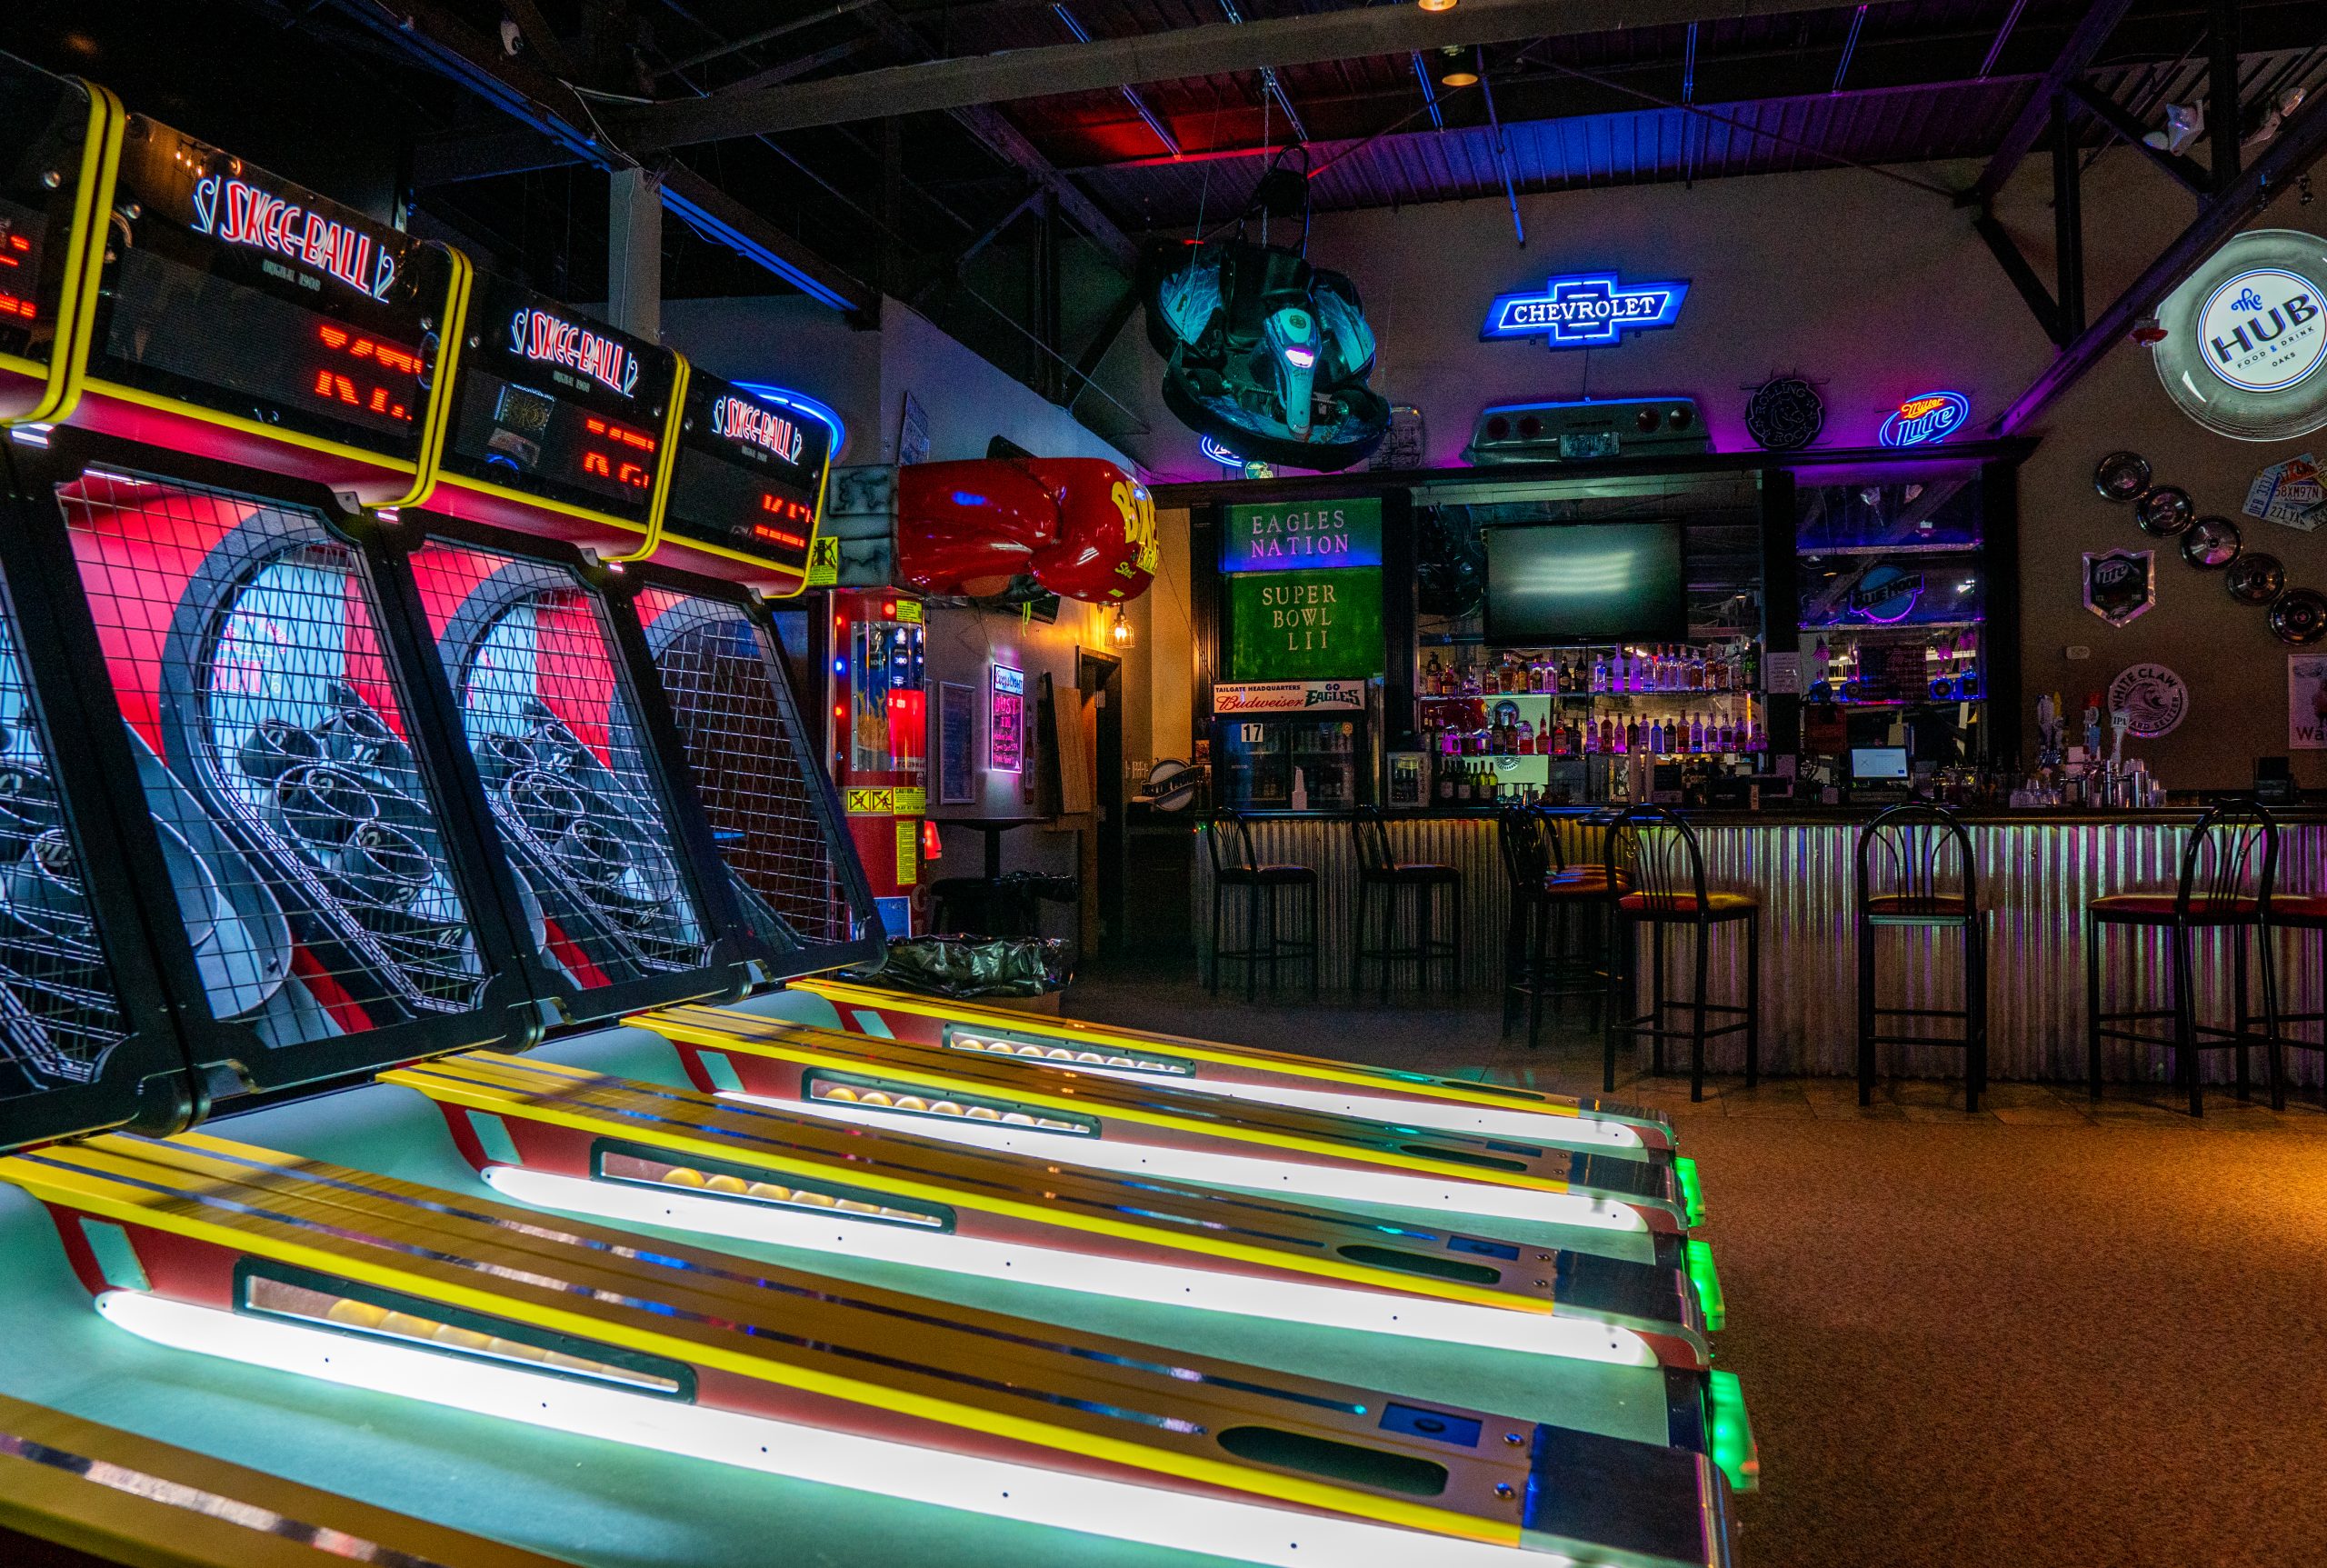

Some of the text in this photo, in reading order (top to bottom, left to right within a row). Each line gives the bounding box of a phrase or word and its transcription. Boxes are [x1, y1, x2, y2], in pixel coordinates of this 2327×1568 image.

[219, 180, 372, 296] SKEE-BALL
[1514, 296, 1654, 323] CHEVROLET
[2231, 288, 2262, 312] The
[2211, 294, 2319, 365] HUB
[527, 311, 623, 394] SKEE-BALL
[2237, 325, 2314, 368] FOOD & DRINK
[2272, 352, 2296, 367] OAKS
[1755, 384, 1806, 414] ROLLING
[1901, 398, 1944, 418] Miller
[724, 397, 791, 462] SKEE-BALL
[1896, 406, 1954, 446] Lite
[1252, 510, 1344, 534] EAGLES
[1251, 534, 1348, 558] NATION
[1262, 584, 1337, 605] SUPER
[1273, 607, 1332, 628] BOWL
[1288, 630, 1327, 651] LII
[1304, 689, 1361, 707] EAGLES
[2112, 668, 2177, 711] WHITE CLAW
[995, 695, 1018, 715] JUST
[1216, 695, 1304, 711] Budweiser
[2153, 696, 2180, 731] SELTZER
[1243, 724, 1262, 741] 17
[2113, 716, 2128, 725] IPA
